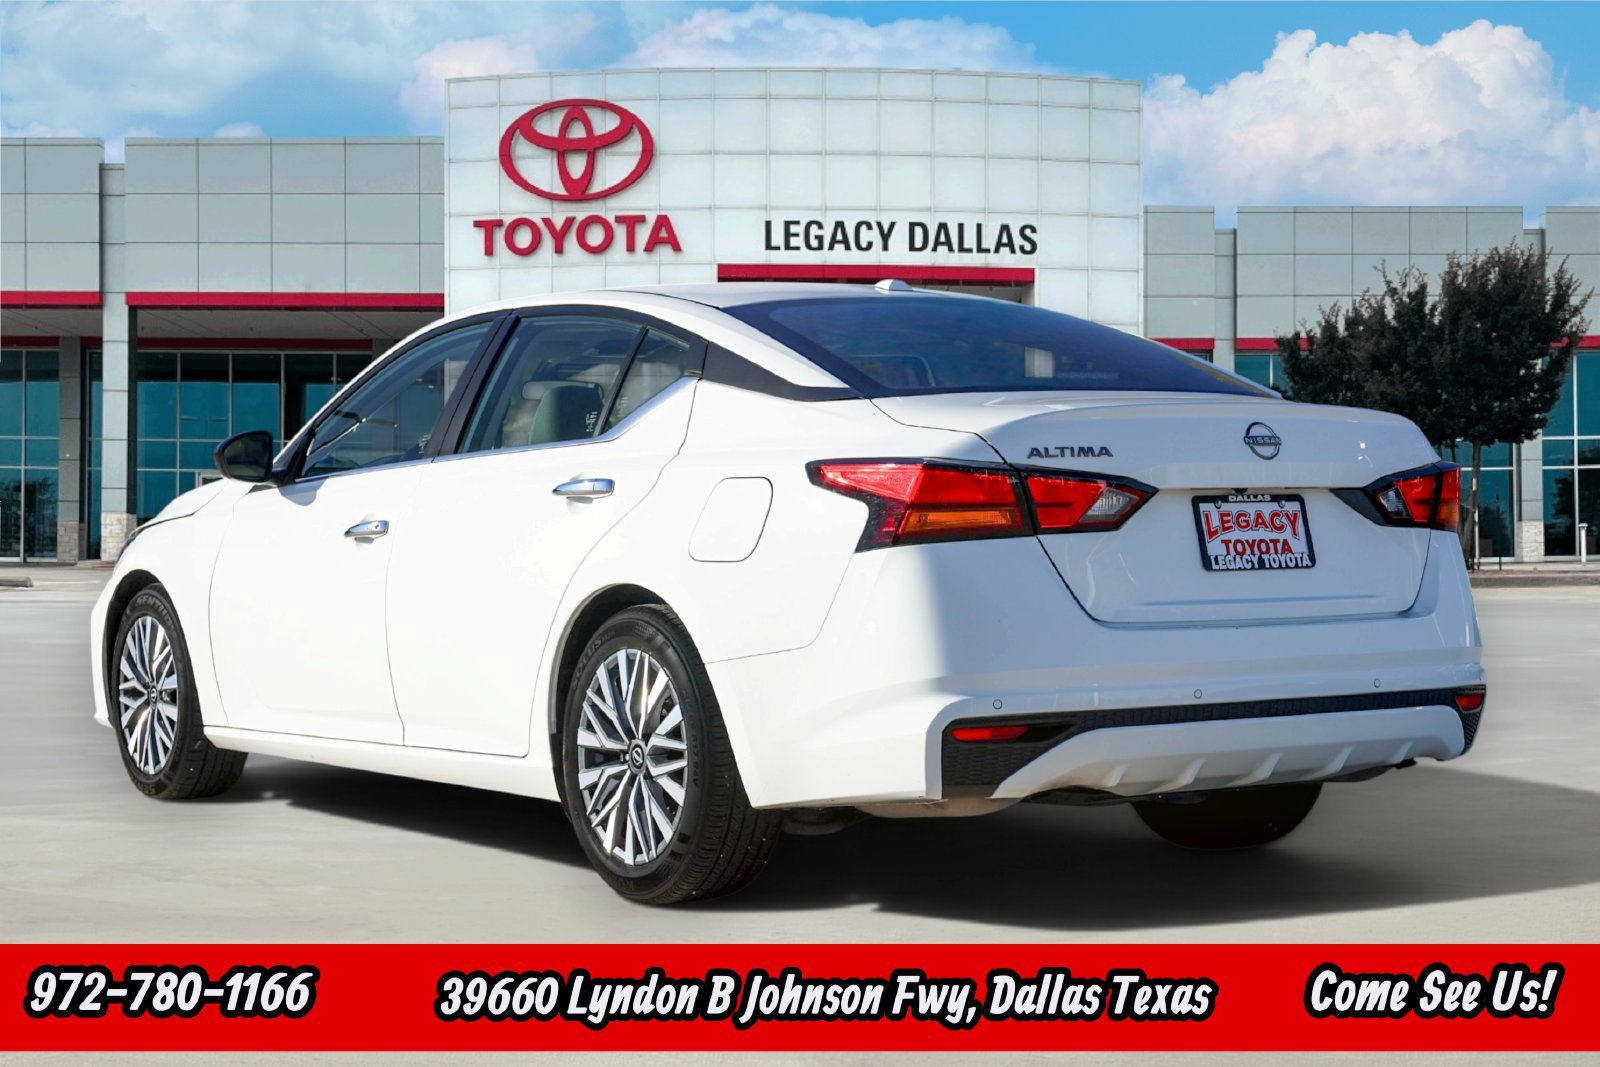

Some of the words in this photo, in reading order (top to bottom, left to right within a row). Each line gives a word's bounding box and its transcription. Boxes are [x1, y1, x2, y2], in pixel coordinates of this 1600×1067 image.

[474, 214, 681, 256] TOYOTA
[765, 220, 896, 252] LEGACY
[909, 221, 1038, 255] DALLAS
[1244, 435, 1281, 446] NISSAN
[1027, 446, 1114, 459] ALTIMA
[1228, 494, 1272, 502] DALLAS
[1203, 510, 1300, 543] LEGACY
[1221, 539, 1294, 556] TOYOTA
[1210, 554, 1259, 570] LEGACY
[1261, 552, 1313, 569] TOYOTA
